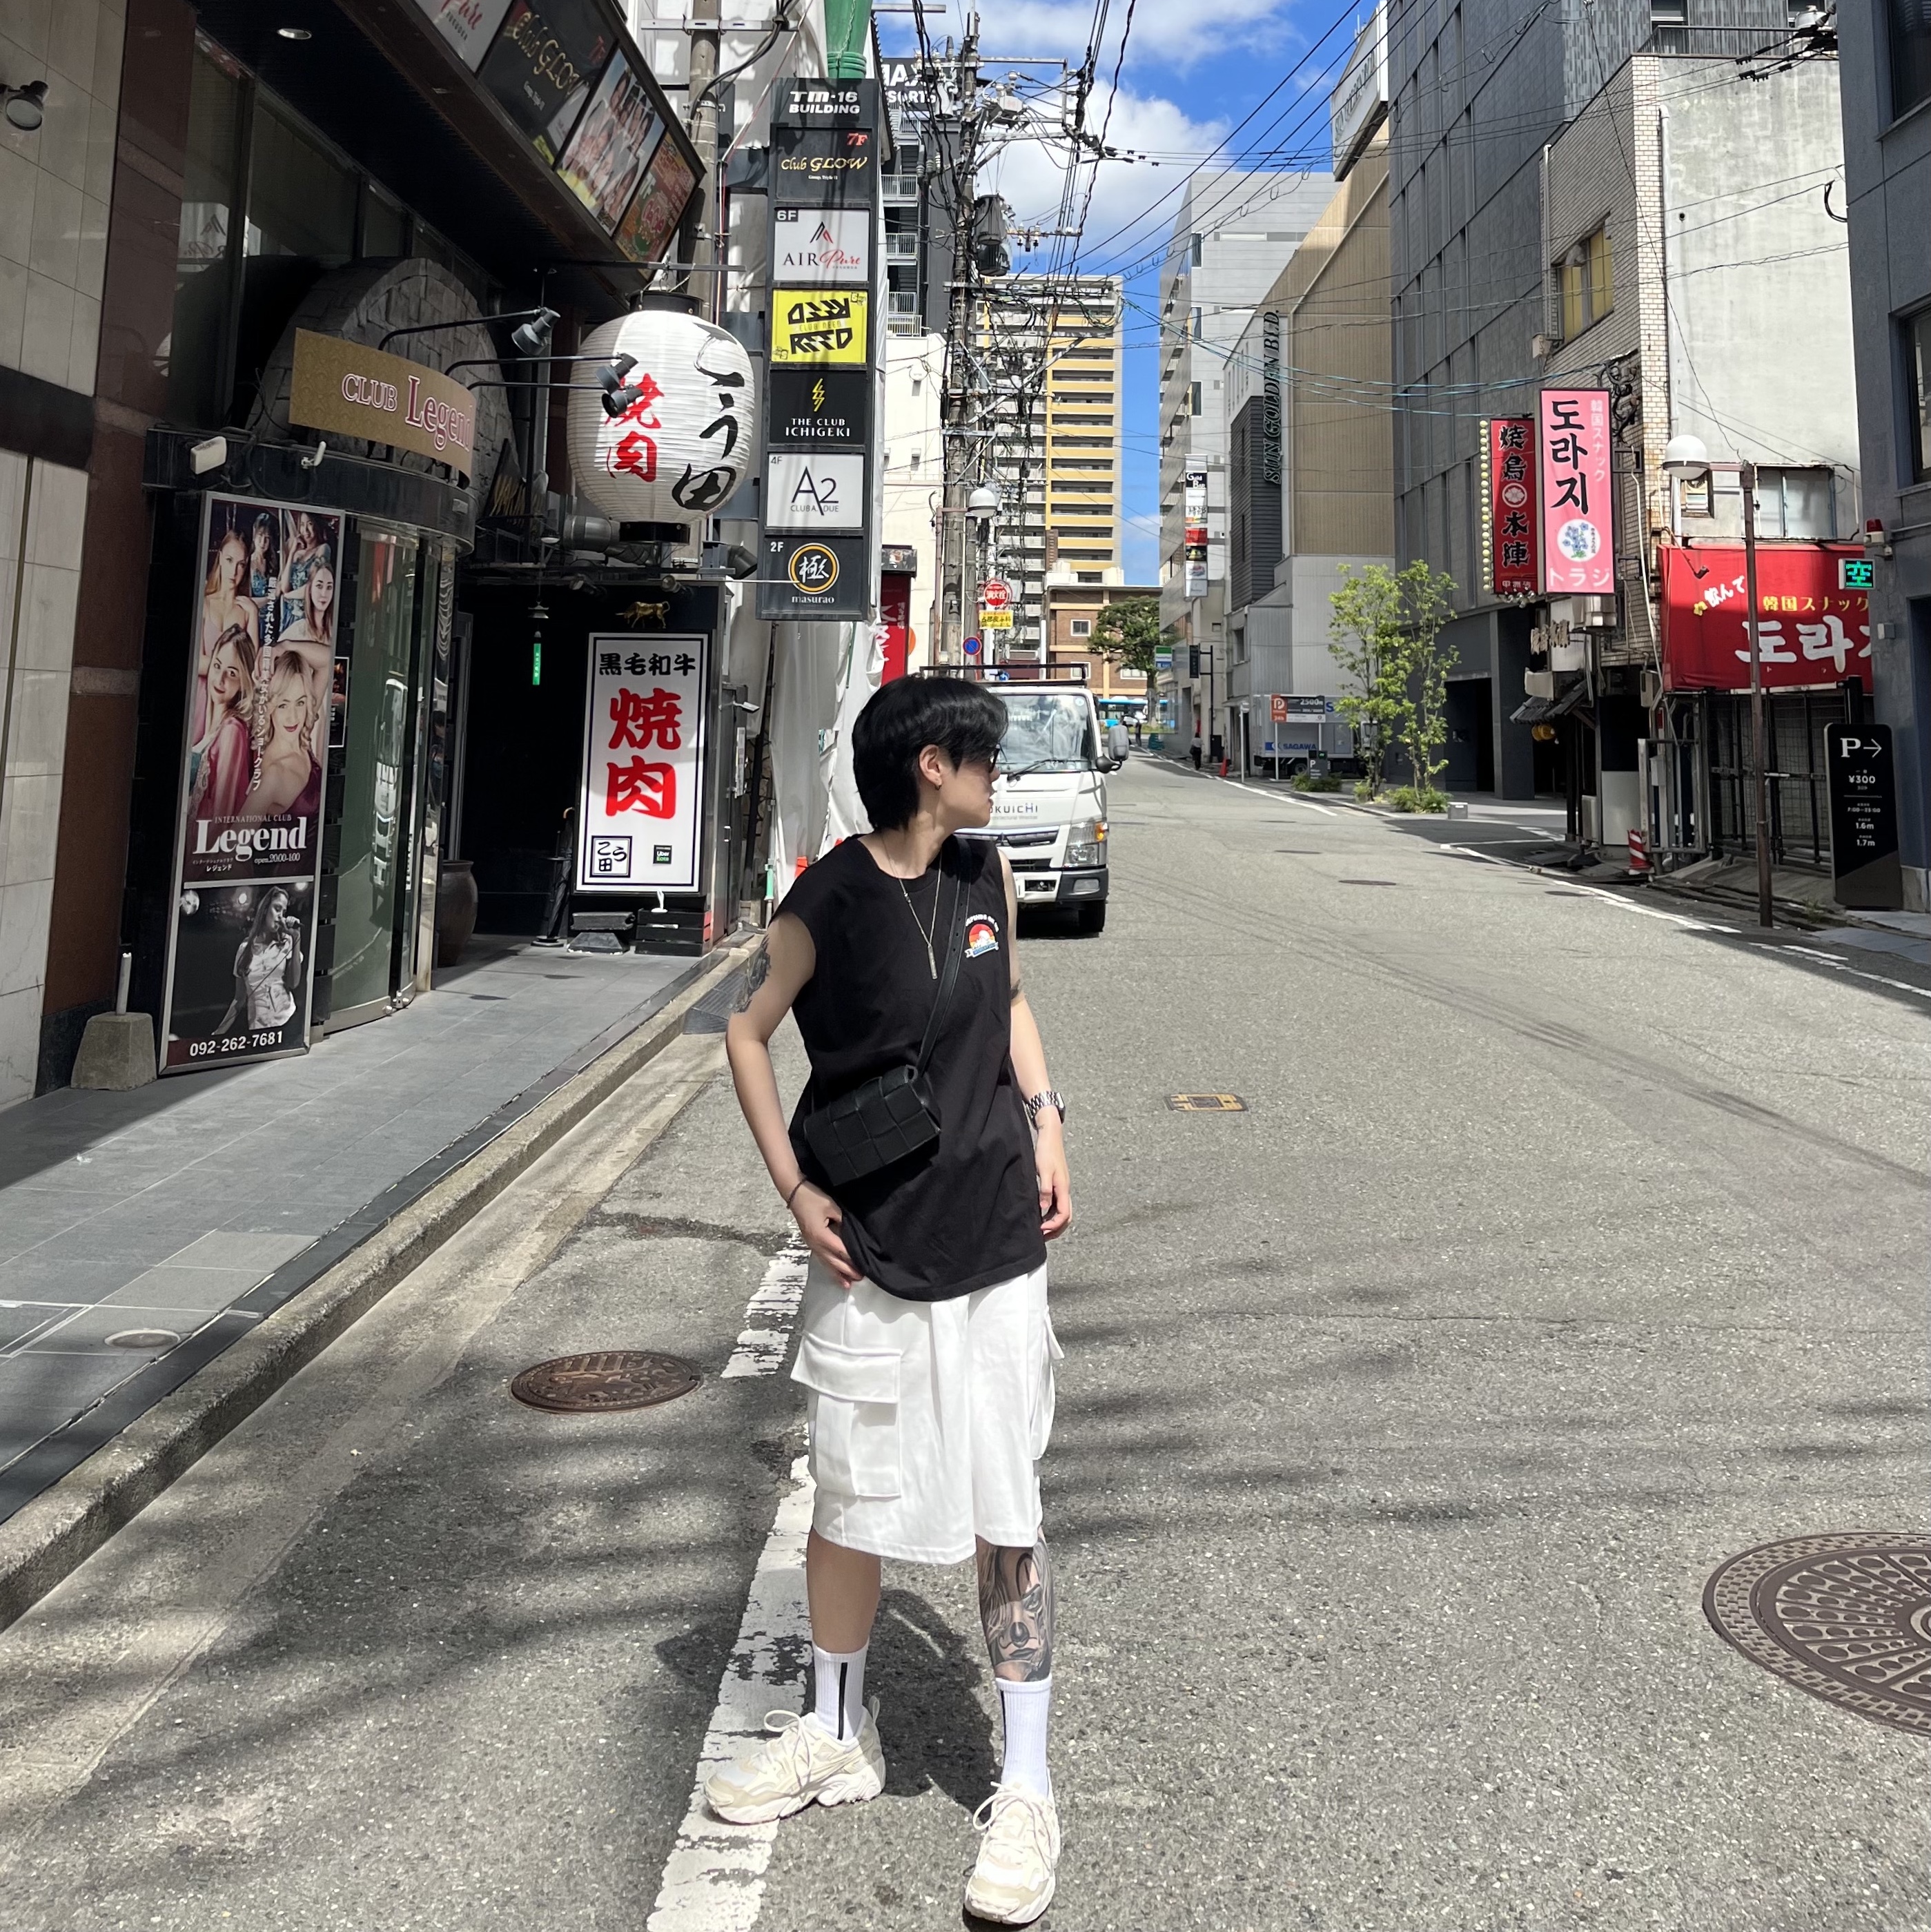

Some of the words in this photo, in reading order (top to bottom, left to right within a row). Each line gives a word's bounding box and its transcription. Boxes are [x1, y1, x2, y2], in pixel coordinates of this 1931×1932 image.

[441, 0, 482, 30] ure
[513, 12, 548, 58] Club
[789, 104, 860, 114] BUILDING
[847, 133, 868, 146] 7F
[781, 157, 807, 170] Club
[810, 156, 868, 172] GLOW
[777, 210, 796, 221] 6F
[783, 252, 819, 266] AIR
[819, 249, 861, 269] Pure
[799, 323, 818, 332] CLUB
[342, 373, 398, 412] CLUB
[1263, 354, 1282, 438] GOLDEN
[785, 427, 850, 437] ICHIGEKI
[1590, 399, 1606, 482] 韓国スナック
[771, 456, 783, 465] 4F
[1263, 438, 1282, 485] SUN
[1499, 424, 1528, 482] 焼鳥
[1549, 400, 1589, 515] 도라지
[791, 466, 839, 516] A2
[770, 541, 784, 552] 2F
[1501, 511, 1531, 568] 本陣
[1549, 567, 1609, 587] トラジ
[1846, 561, 1872, 587] 空
[792, 596, 834, 604] masurao
[1704, 576, 1745, 607] 飲んで
[1763, 596, 1869, 612] 韓国スナック
[599, 652, 696, 676] 黒毛和牛
[605, 687, 683, 819] 焼肉
[1840, 737, 1861, 758] P
[1848, 775, 1876, 783] ¥300
[215, 815, 271, 823] INTERNATIONAL
[193, 817, 307, 861] Legend
[190, 1031, 283, 1057] 092-262-7681
